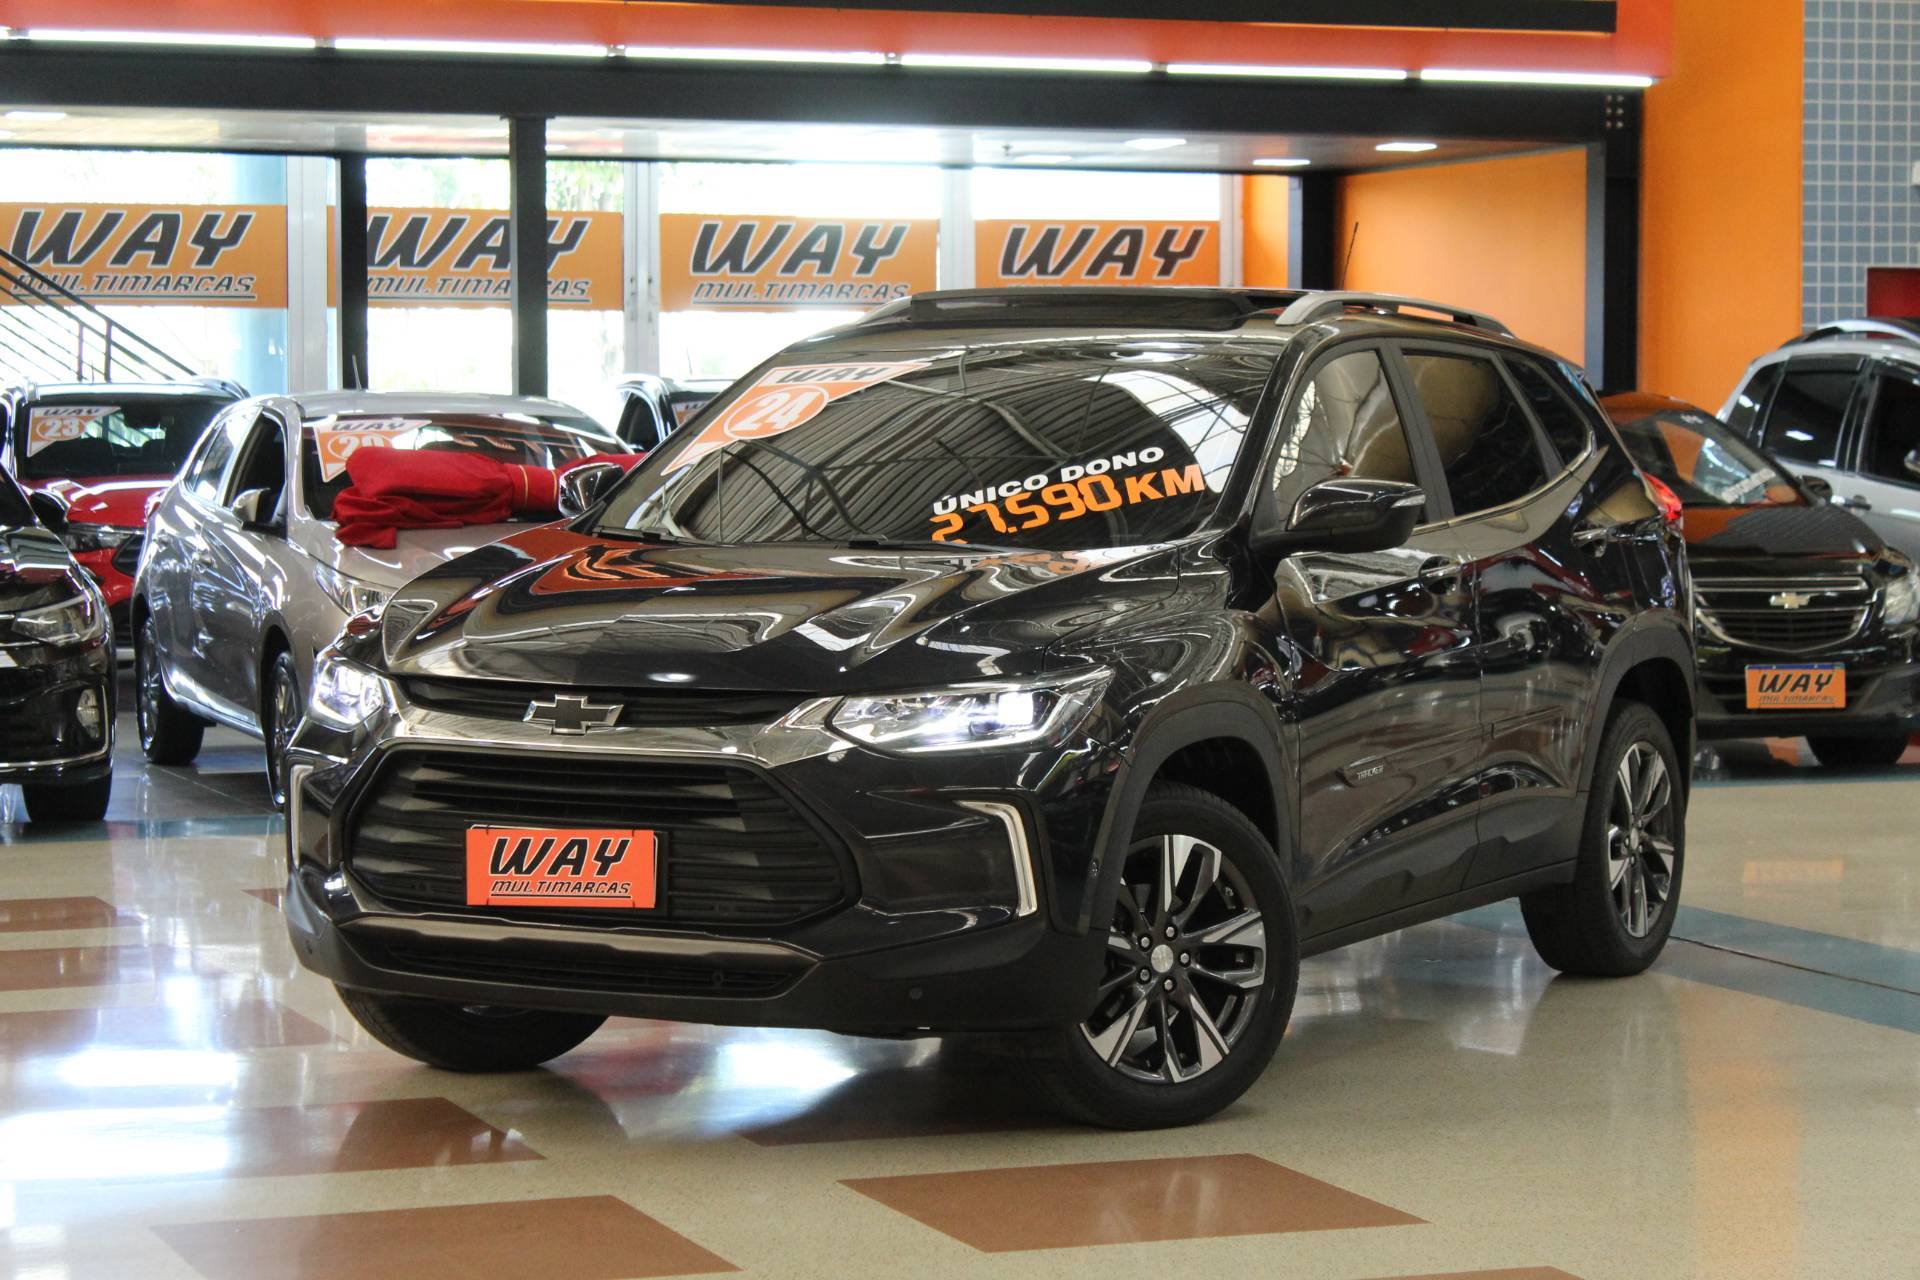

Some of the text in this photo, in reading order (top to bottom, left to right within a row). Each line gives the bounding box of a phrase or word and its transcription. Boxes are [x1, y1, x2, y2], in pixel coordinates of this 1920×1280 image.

[10, 209, 256, 269] WAY
[690, 221, 911, 277] WAY
[999, 224, 1209, 280] WAY
[367, 275, 592, 297] MULTIMAAS
[692, 281, 911, 300] MULTIMARCAS
[776, 367, 890, 383] WAY
[45, 417, 80, 437] 23
[729, 391, 822, 432] 24
[932, 446, 1165, 516] ÚNICO DONO
[1758, 672, 1834, 693] WAY
[489, 836, 631, 877] WAY
[490, 880, 631, 894] MULTIMARCAS
